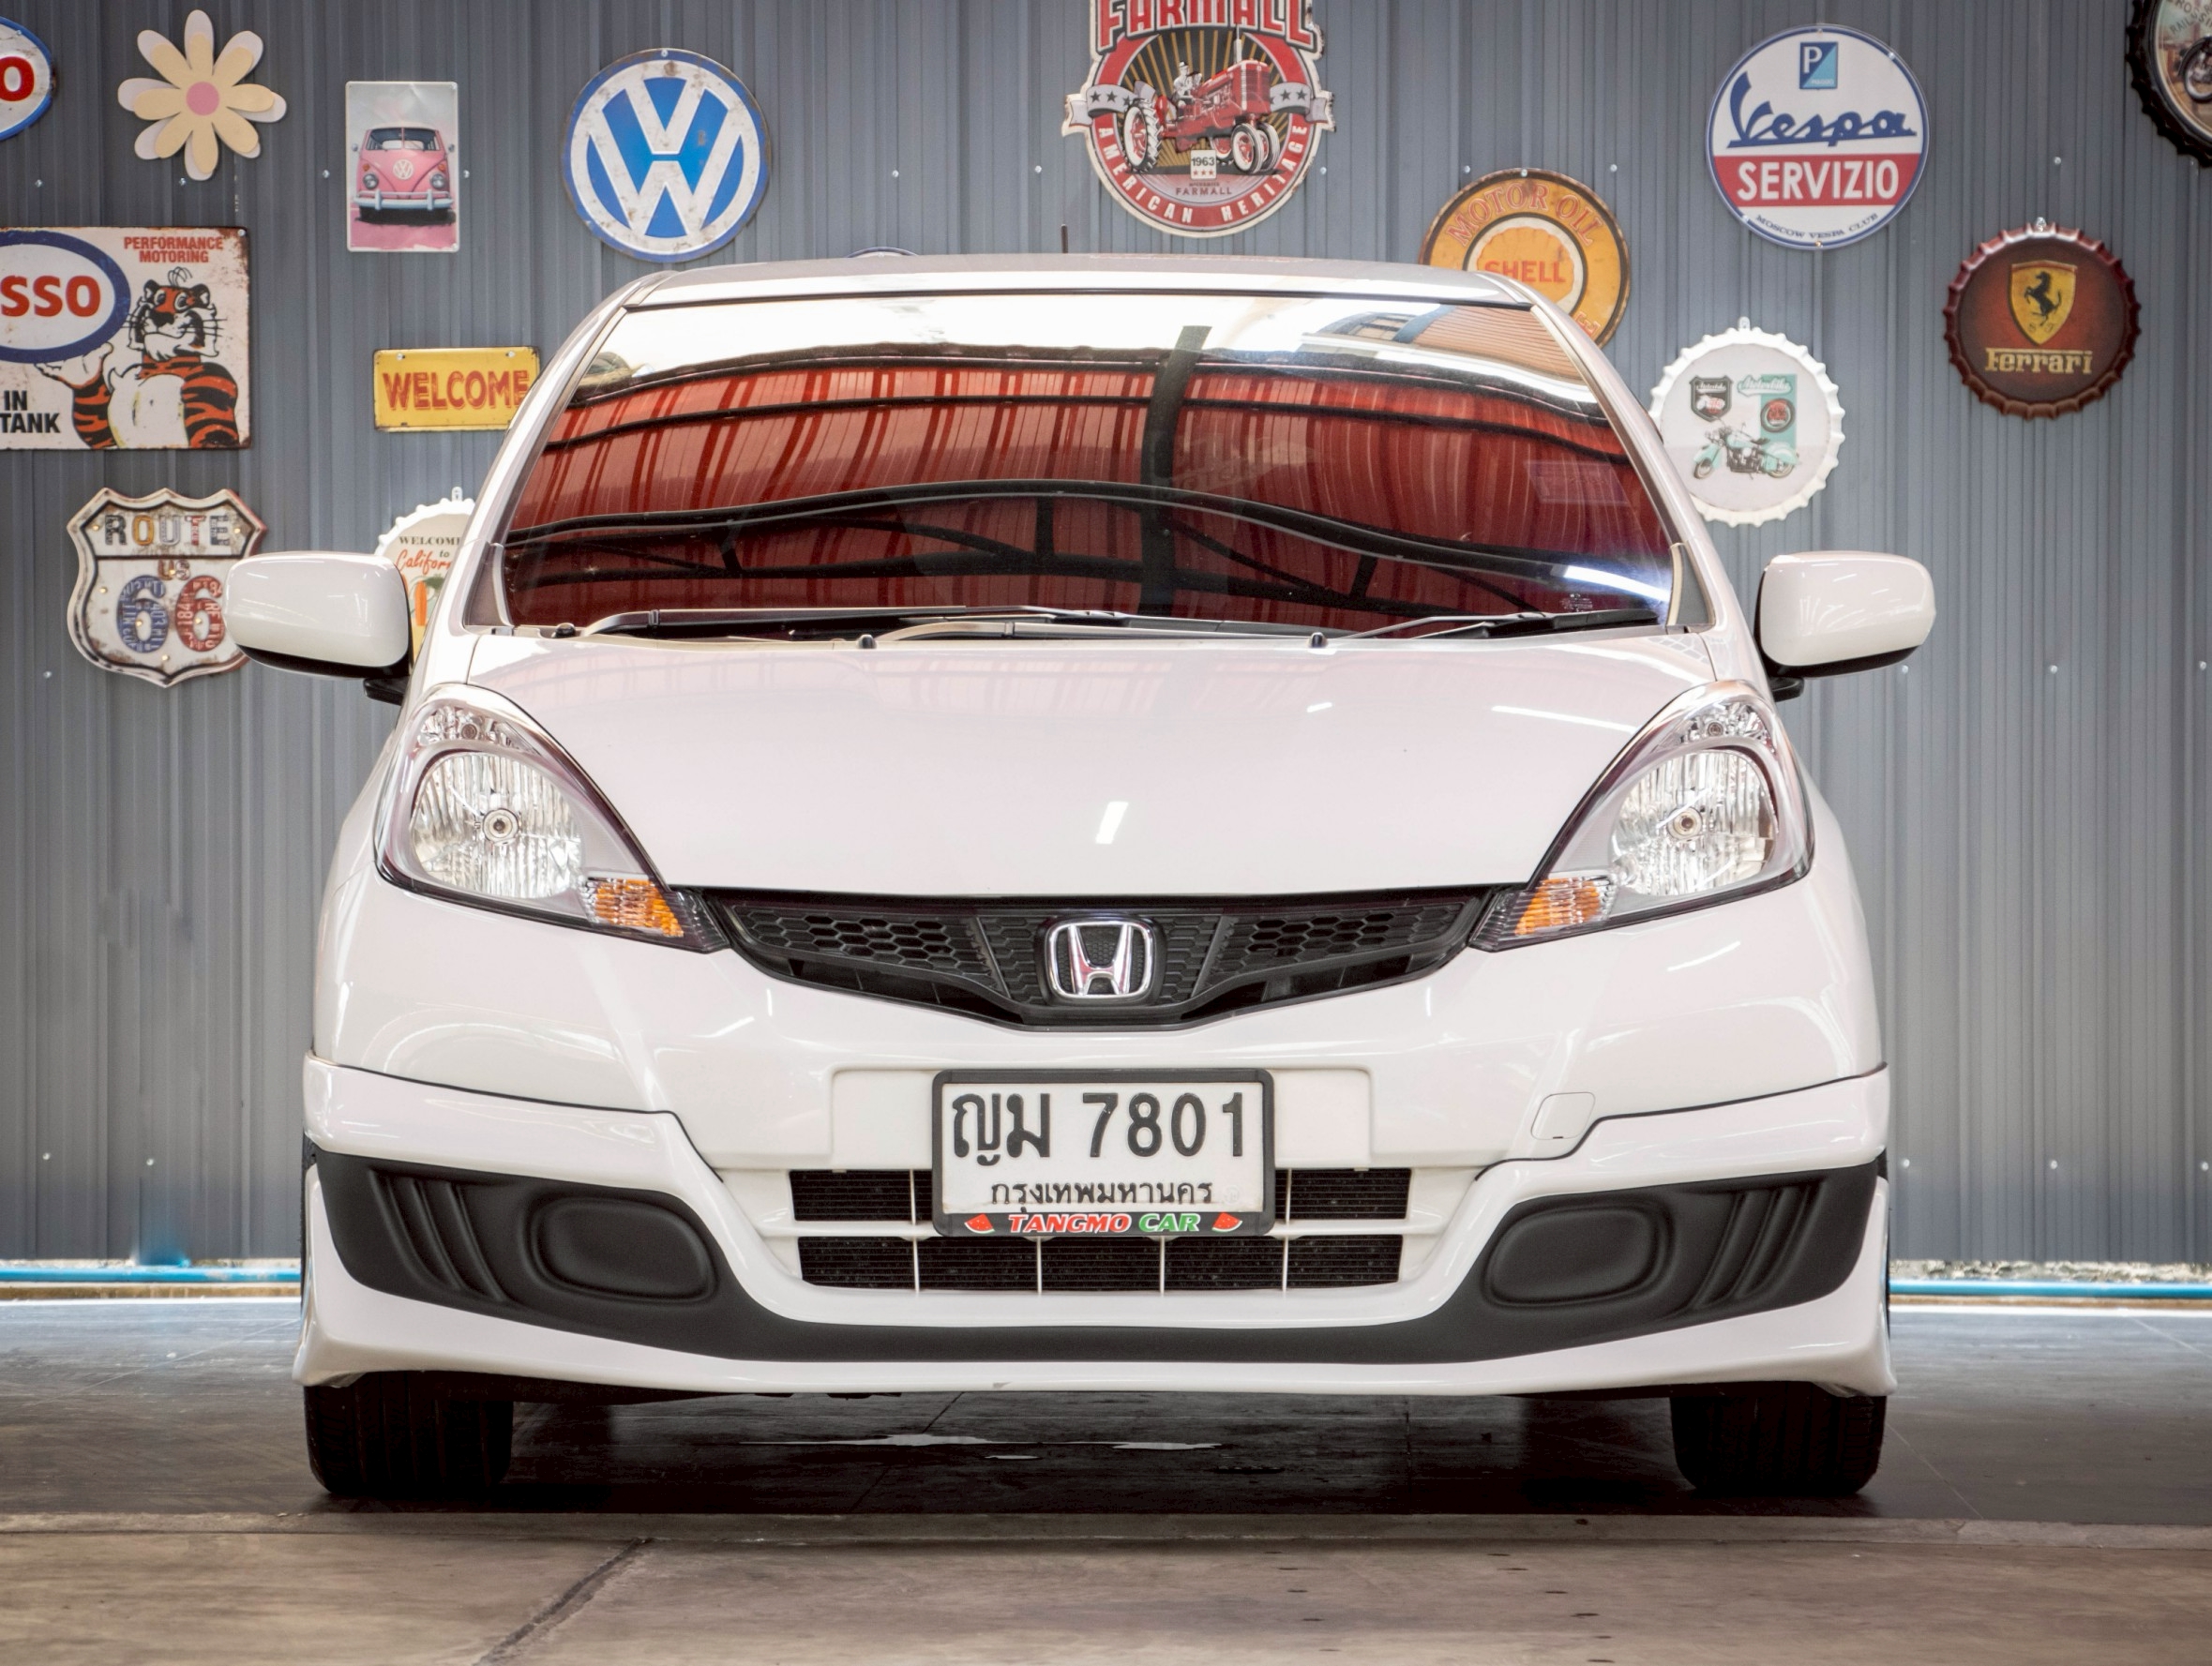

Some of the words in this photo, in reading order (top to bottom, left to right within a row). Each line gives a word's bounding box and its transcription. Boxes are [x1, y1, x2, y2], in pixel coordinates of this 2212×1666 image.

[1803, 46, 1823, 73] P
[1726, 70, 1918, 148] Vespa
[1098, 128, 1193, 224] AMERICAN
[1221, 125, 1308, 222] HERITAGE
[1192, 157, 1215, 167] 1963
[1176, 187, 1232, 196] FARMALL
[1737, 159, 1900, 201] SERVIZIO
[1447, 183, 1549, 247] MOTOR
[1556, 194, 1603, 247] OIL
[1756, 215, 1805, 238] MOSCOW
[1809, 229, 1844, 238] VESPA
[1848, 213, 1878, 232] CLUB
[124, 236, 223, 250] PERFORMANCE
[139, 250, 208, 263] MOTORING
[1985, 348, 2093, 373] Ferrari
[4, 390, 28, 412] IN
[383, 369, 530, 411] WELCOME
[0, 413, 61, 434] TANK
[105, 515, 231, 547] ROUTE
[440, 549, 450, 558] to
[116, 575, 225, 653] 66
[952, 1092, 1050, 1166] ญม
[1082, 1092, 1243, 1157] 7801
[991, 1181, 1212, 1212] กรุงเทพมหานคร
[1008, 1213, 1131, 1234] TANGMO
[1137, 1212, 1201, 1232] CAR
